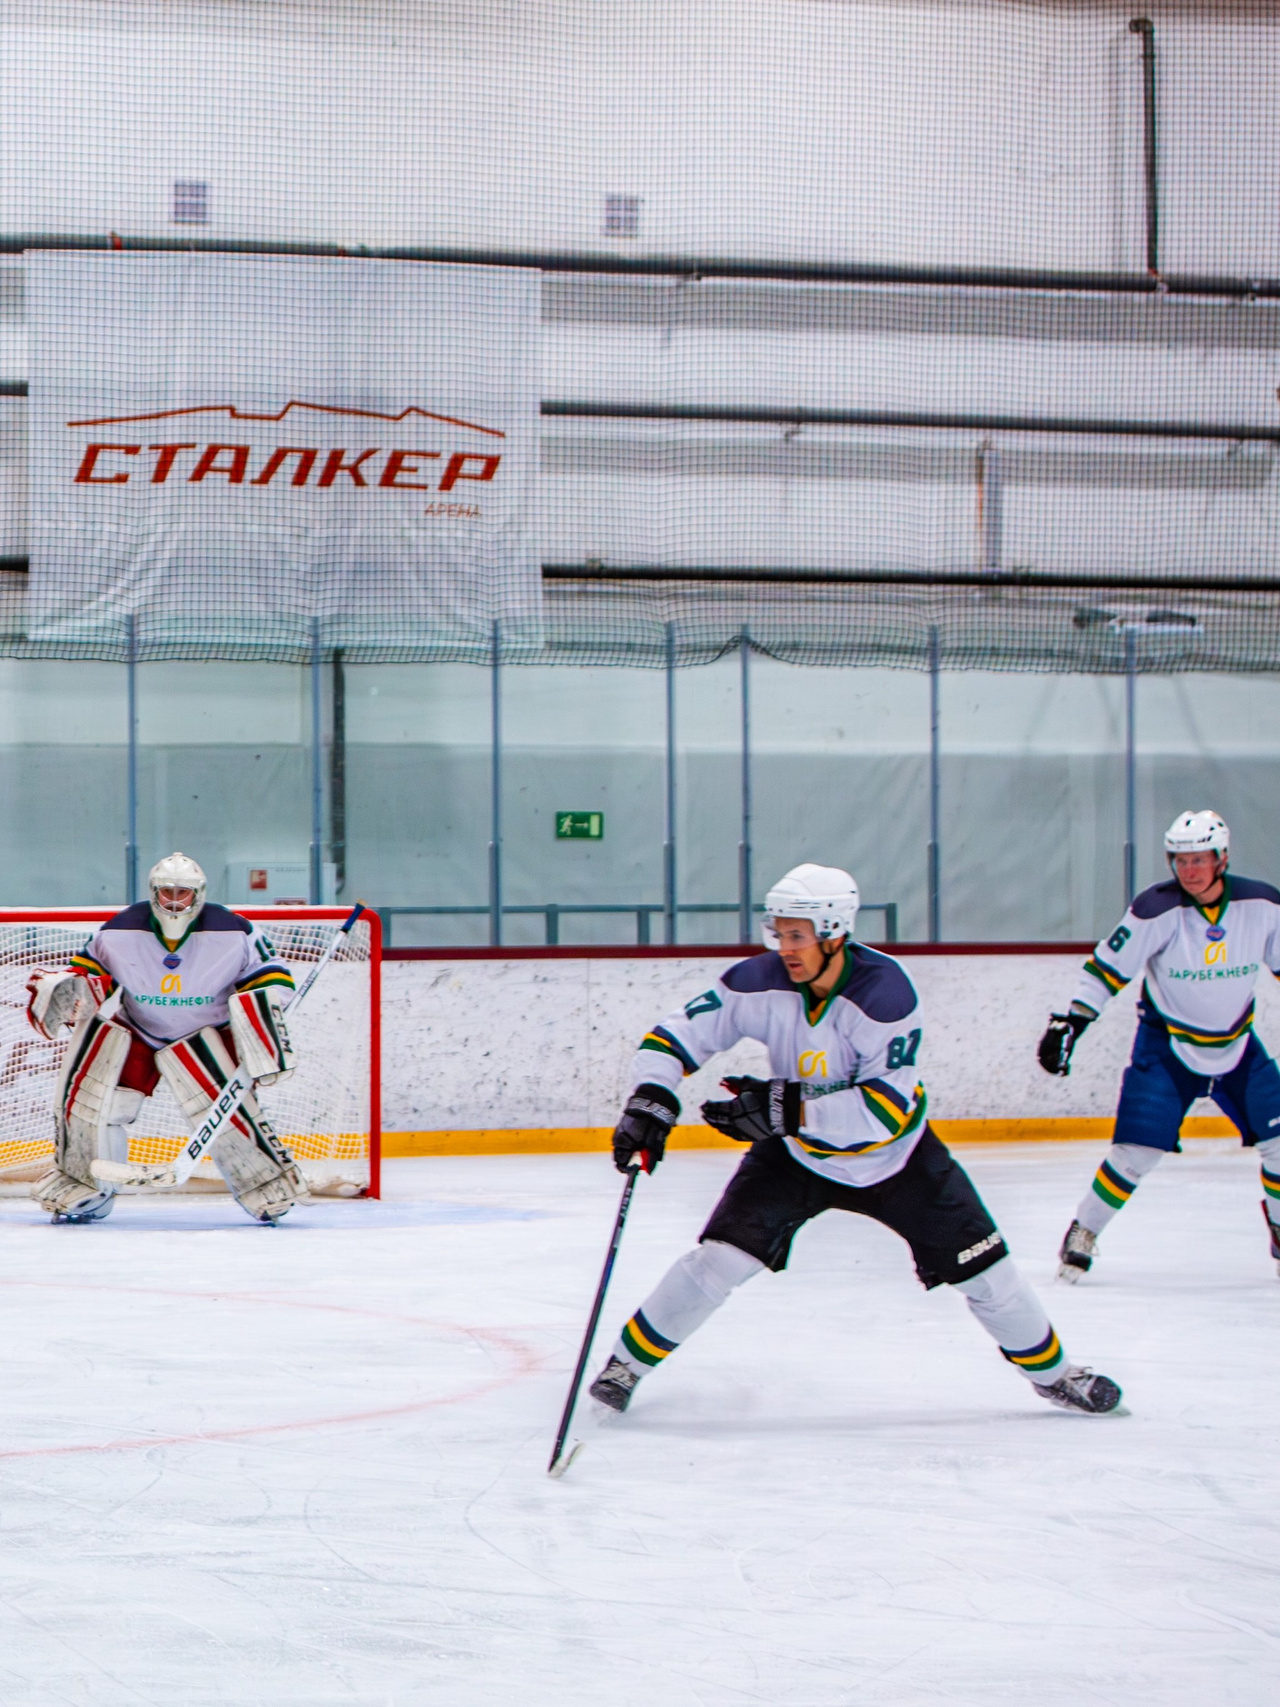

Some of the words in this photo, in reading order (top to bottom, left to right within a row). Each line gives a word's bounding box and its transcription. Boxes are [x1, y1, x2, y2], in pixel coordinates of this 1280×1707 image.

[73, 442, 502, 492] СТАЛКЕР
[424, 502, 481, 518] АРЕНА
[1107, 926, 1131, 952] 6
[684, 989, 722, 1020] 7
[271, 1004, 294, 1053] CCM
[886, 1028, 922, 1070] 87
[188, 1078, 244, 1160] BAUER
[258, 1120, 293, 1164] CCM
